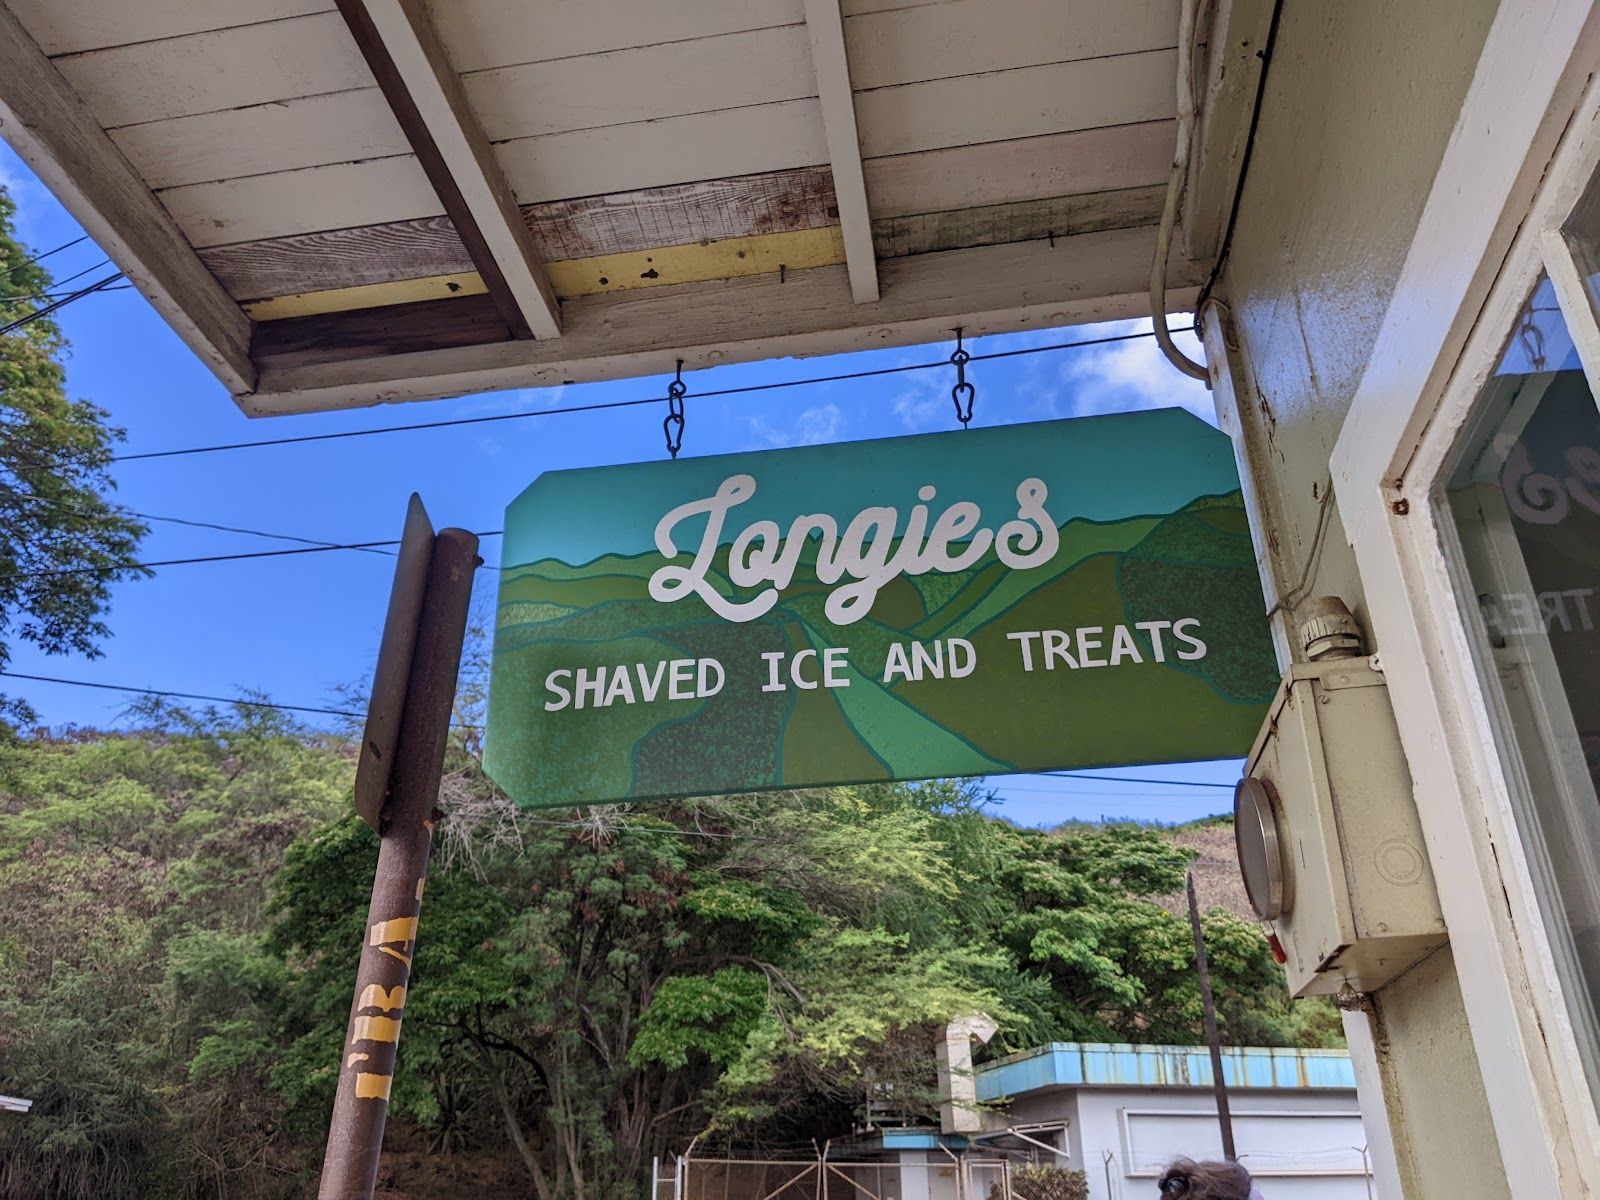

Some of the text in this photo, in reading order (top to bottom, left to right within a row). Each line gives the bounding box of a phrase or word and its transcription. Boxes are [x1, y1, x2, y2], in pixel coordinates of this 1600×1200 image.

[544, 617, 1208, 712] SHAVED ICE AND TREATS
